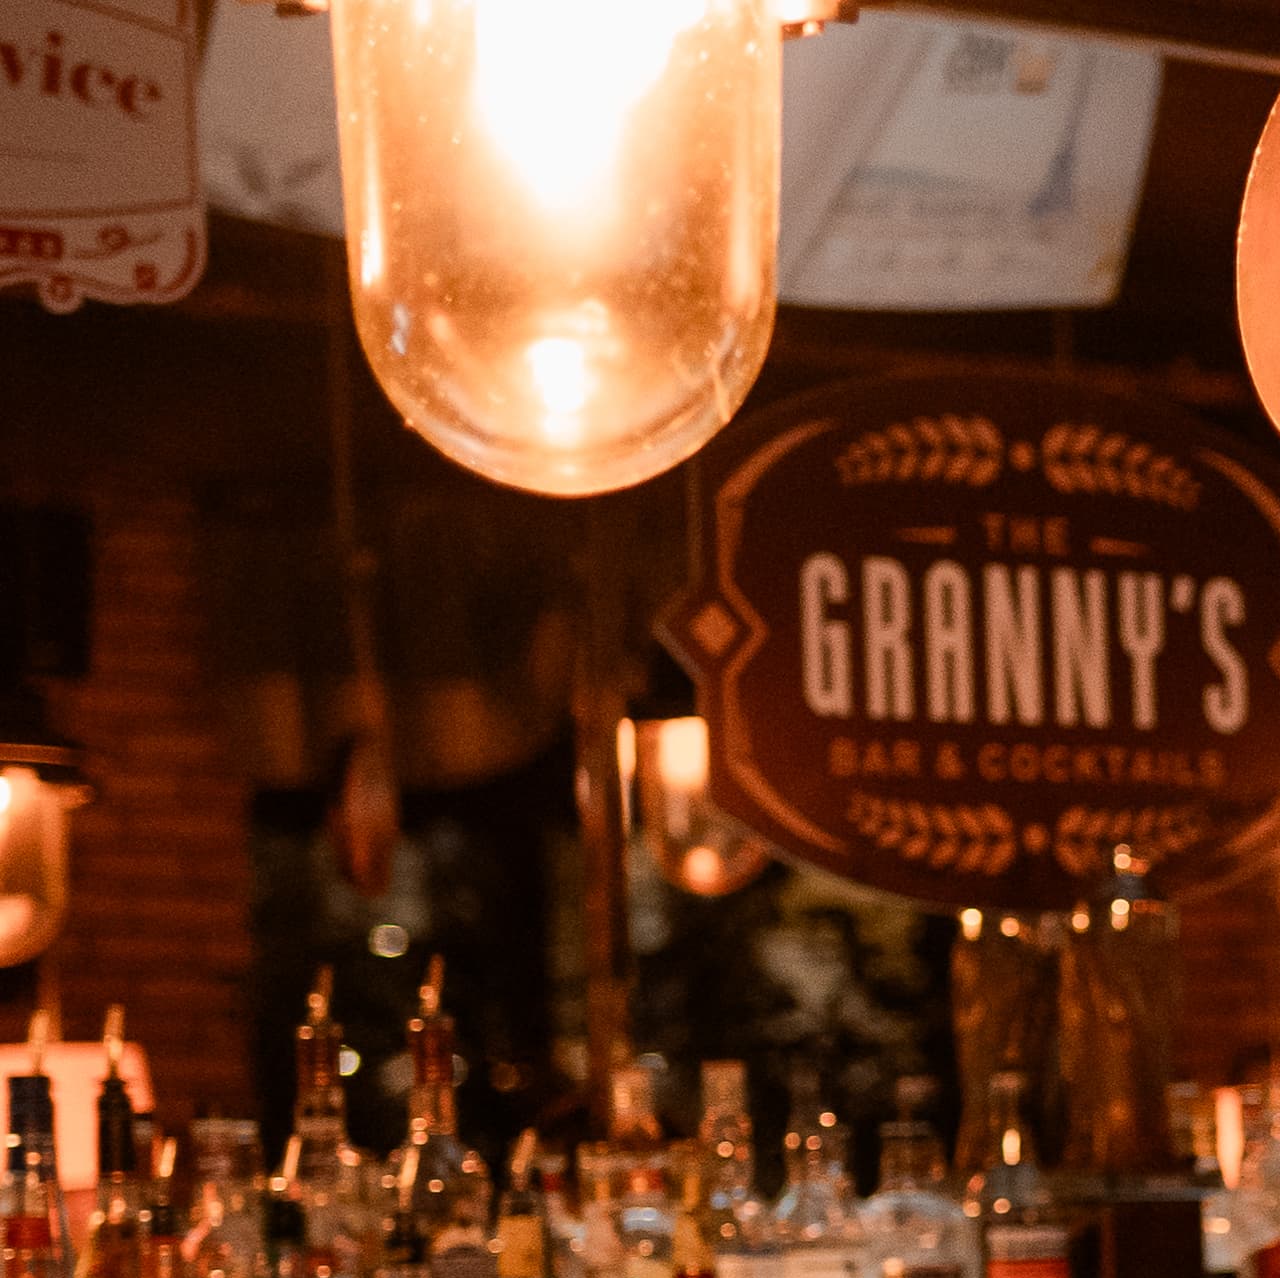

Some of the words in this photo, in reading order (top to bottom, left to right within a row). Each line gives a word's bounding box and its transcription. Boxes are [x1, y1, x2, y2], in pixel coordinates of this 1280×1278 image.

[982, 514, 1068, 553] THE
[801, 552, 1250, 733] GRANNY'S
[828, 736, 921, 778] BAR
[935, 741, 966, 781] &
[977, 743, 1226, 786] COCKTAILS
